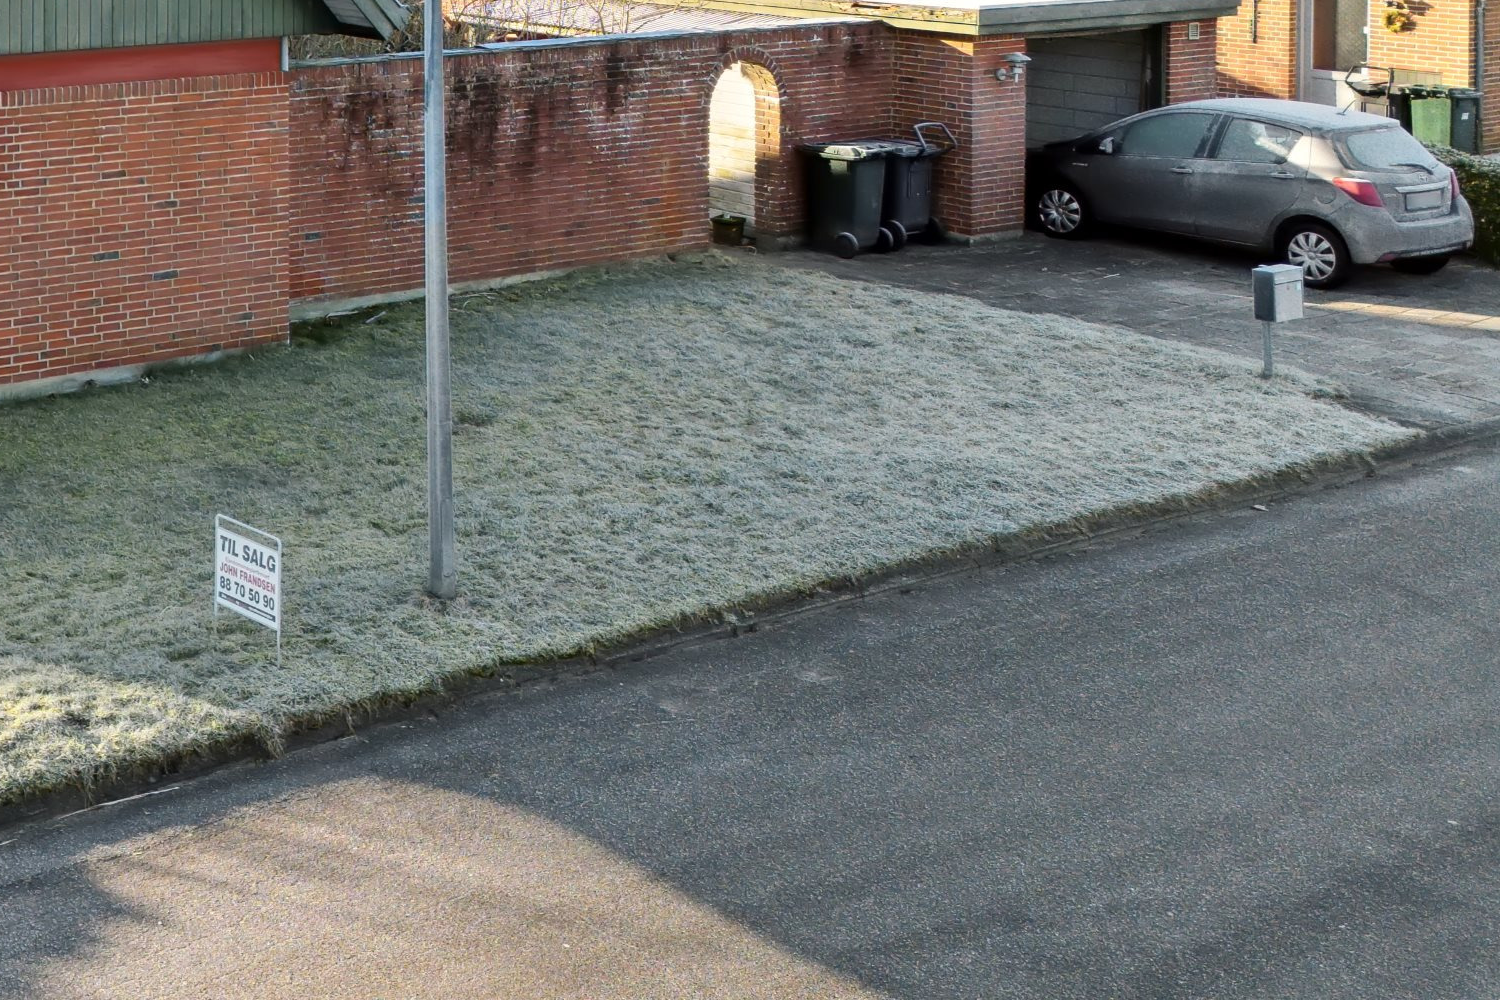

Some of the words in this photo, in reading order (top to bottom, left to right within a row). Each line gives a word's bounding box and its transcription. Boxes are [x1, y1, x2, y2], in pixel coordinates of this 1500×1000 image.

[220, 534, 239, 558] TIL
[242, 544, 276, 574] SALG
[220, 562, 238, 578] JOHN
[239, 569, 276, 595] FRANDSEN
[220, 575, 231, 591] 88
[234, 581, 246, 598] 70
[248, 588, 260, 604] 50
[263, 594, 275, 611] 90
